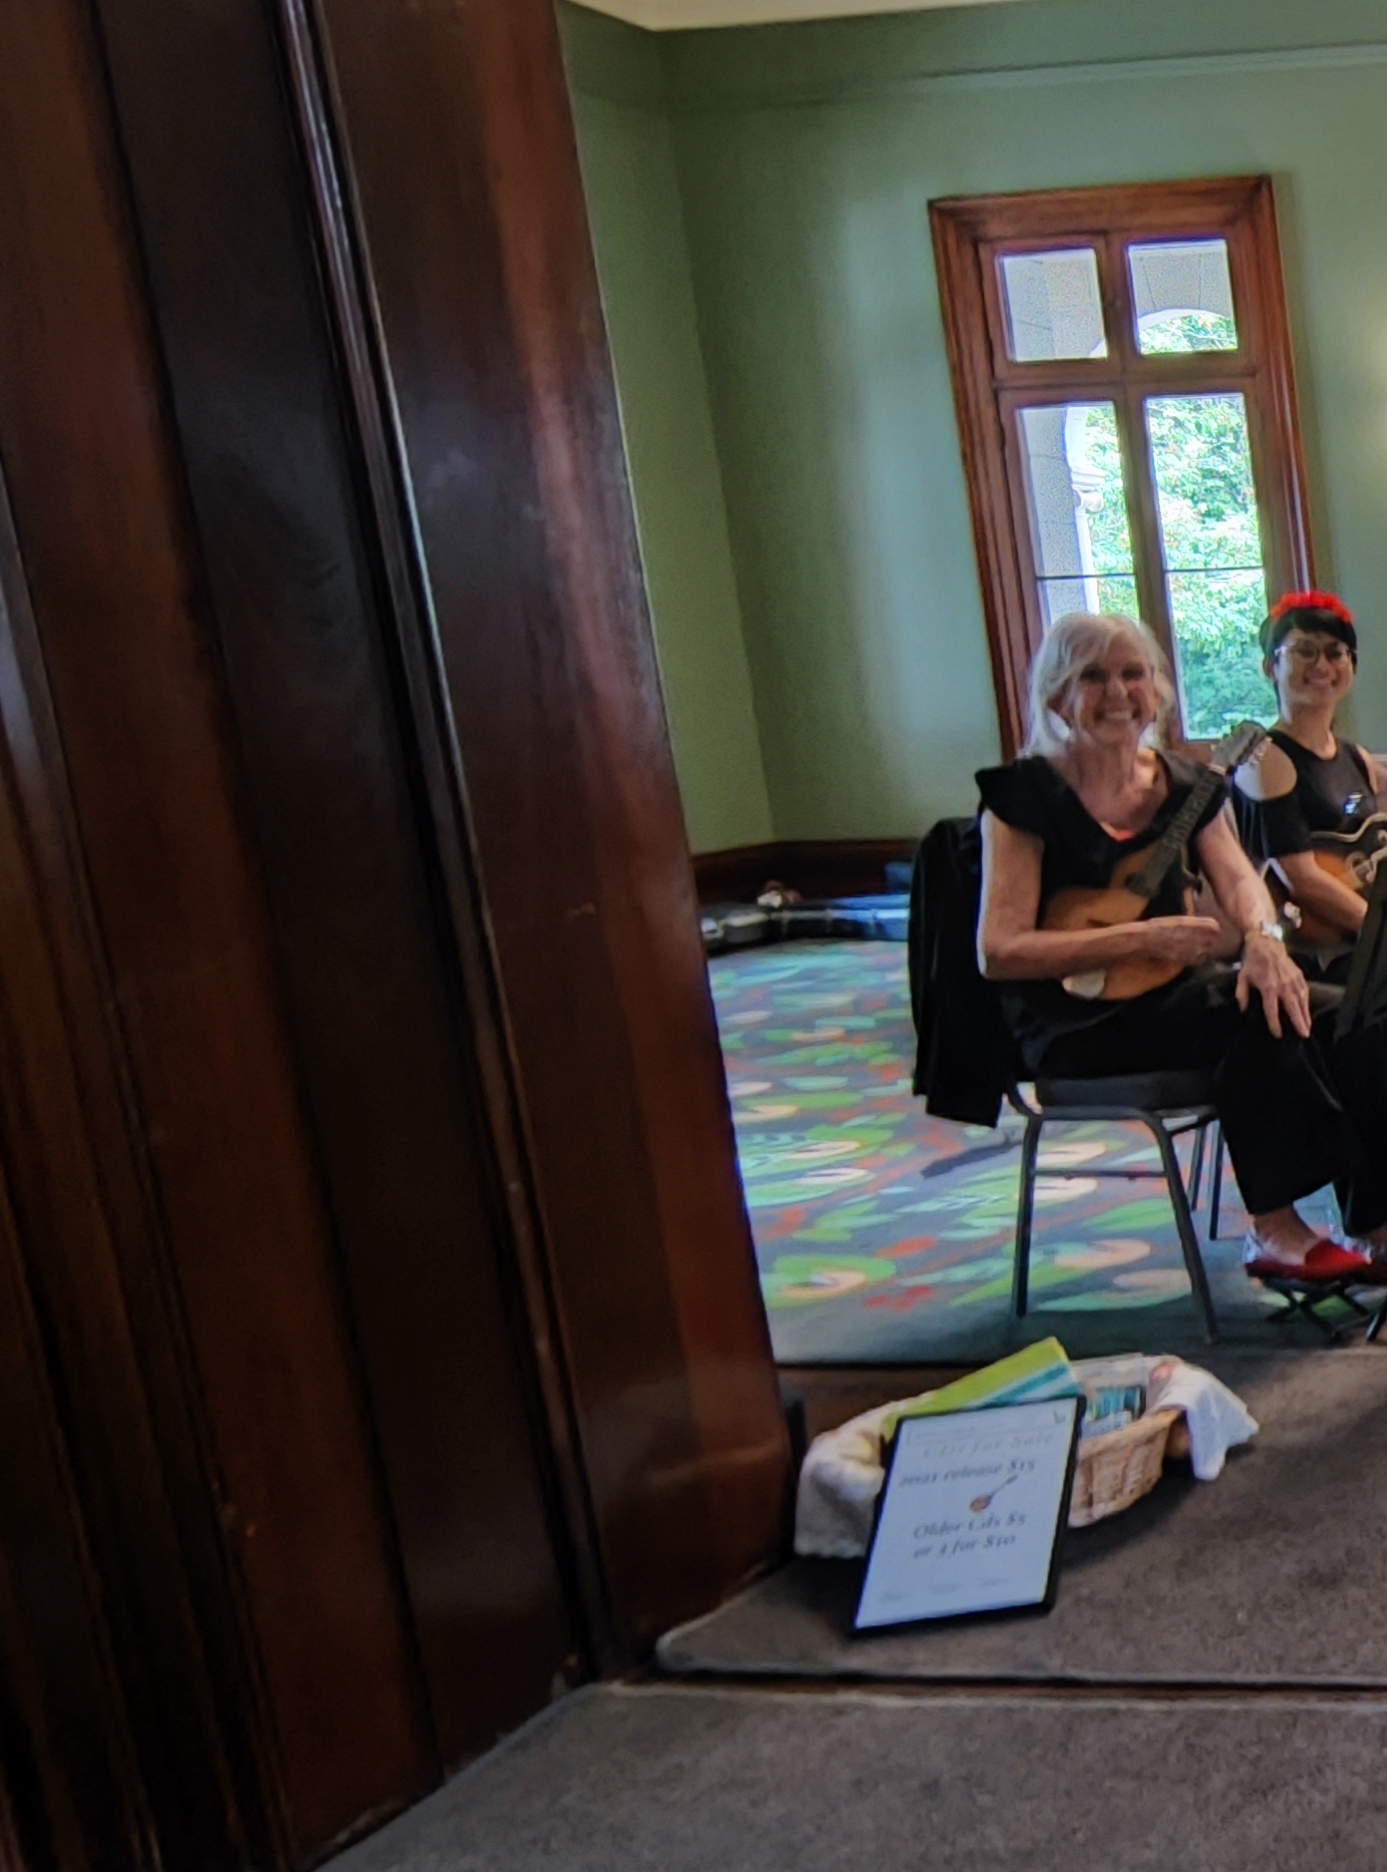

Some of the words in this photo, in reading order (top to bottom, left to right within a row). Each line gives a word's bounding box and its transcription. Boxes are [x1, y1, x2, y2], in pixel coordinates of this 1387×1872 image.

[943, 1463, 1003, 1482] release
[913, 1520, 962, 1539] Older
[949, 1538, 979, 1557] for
